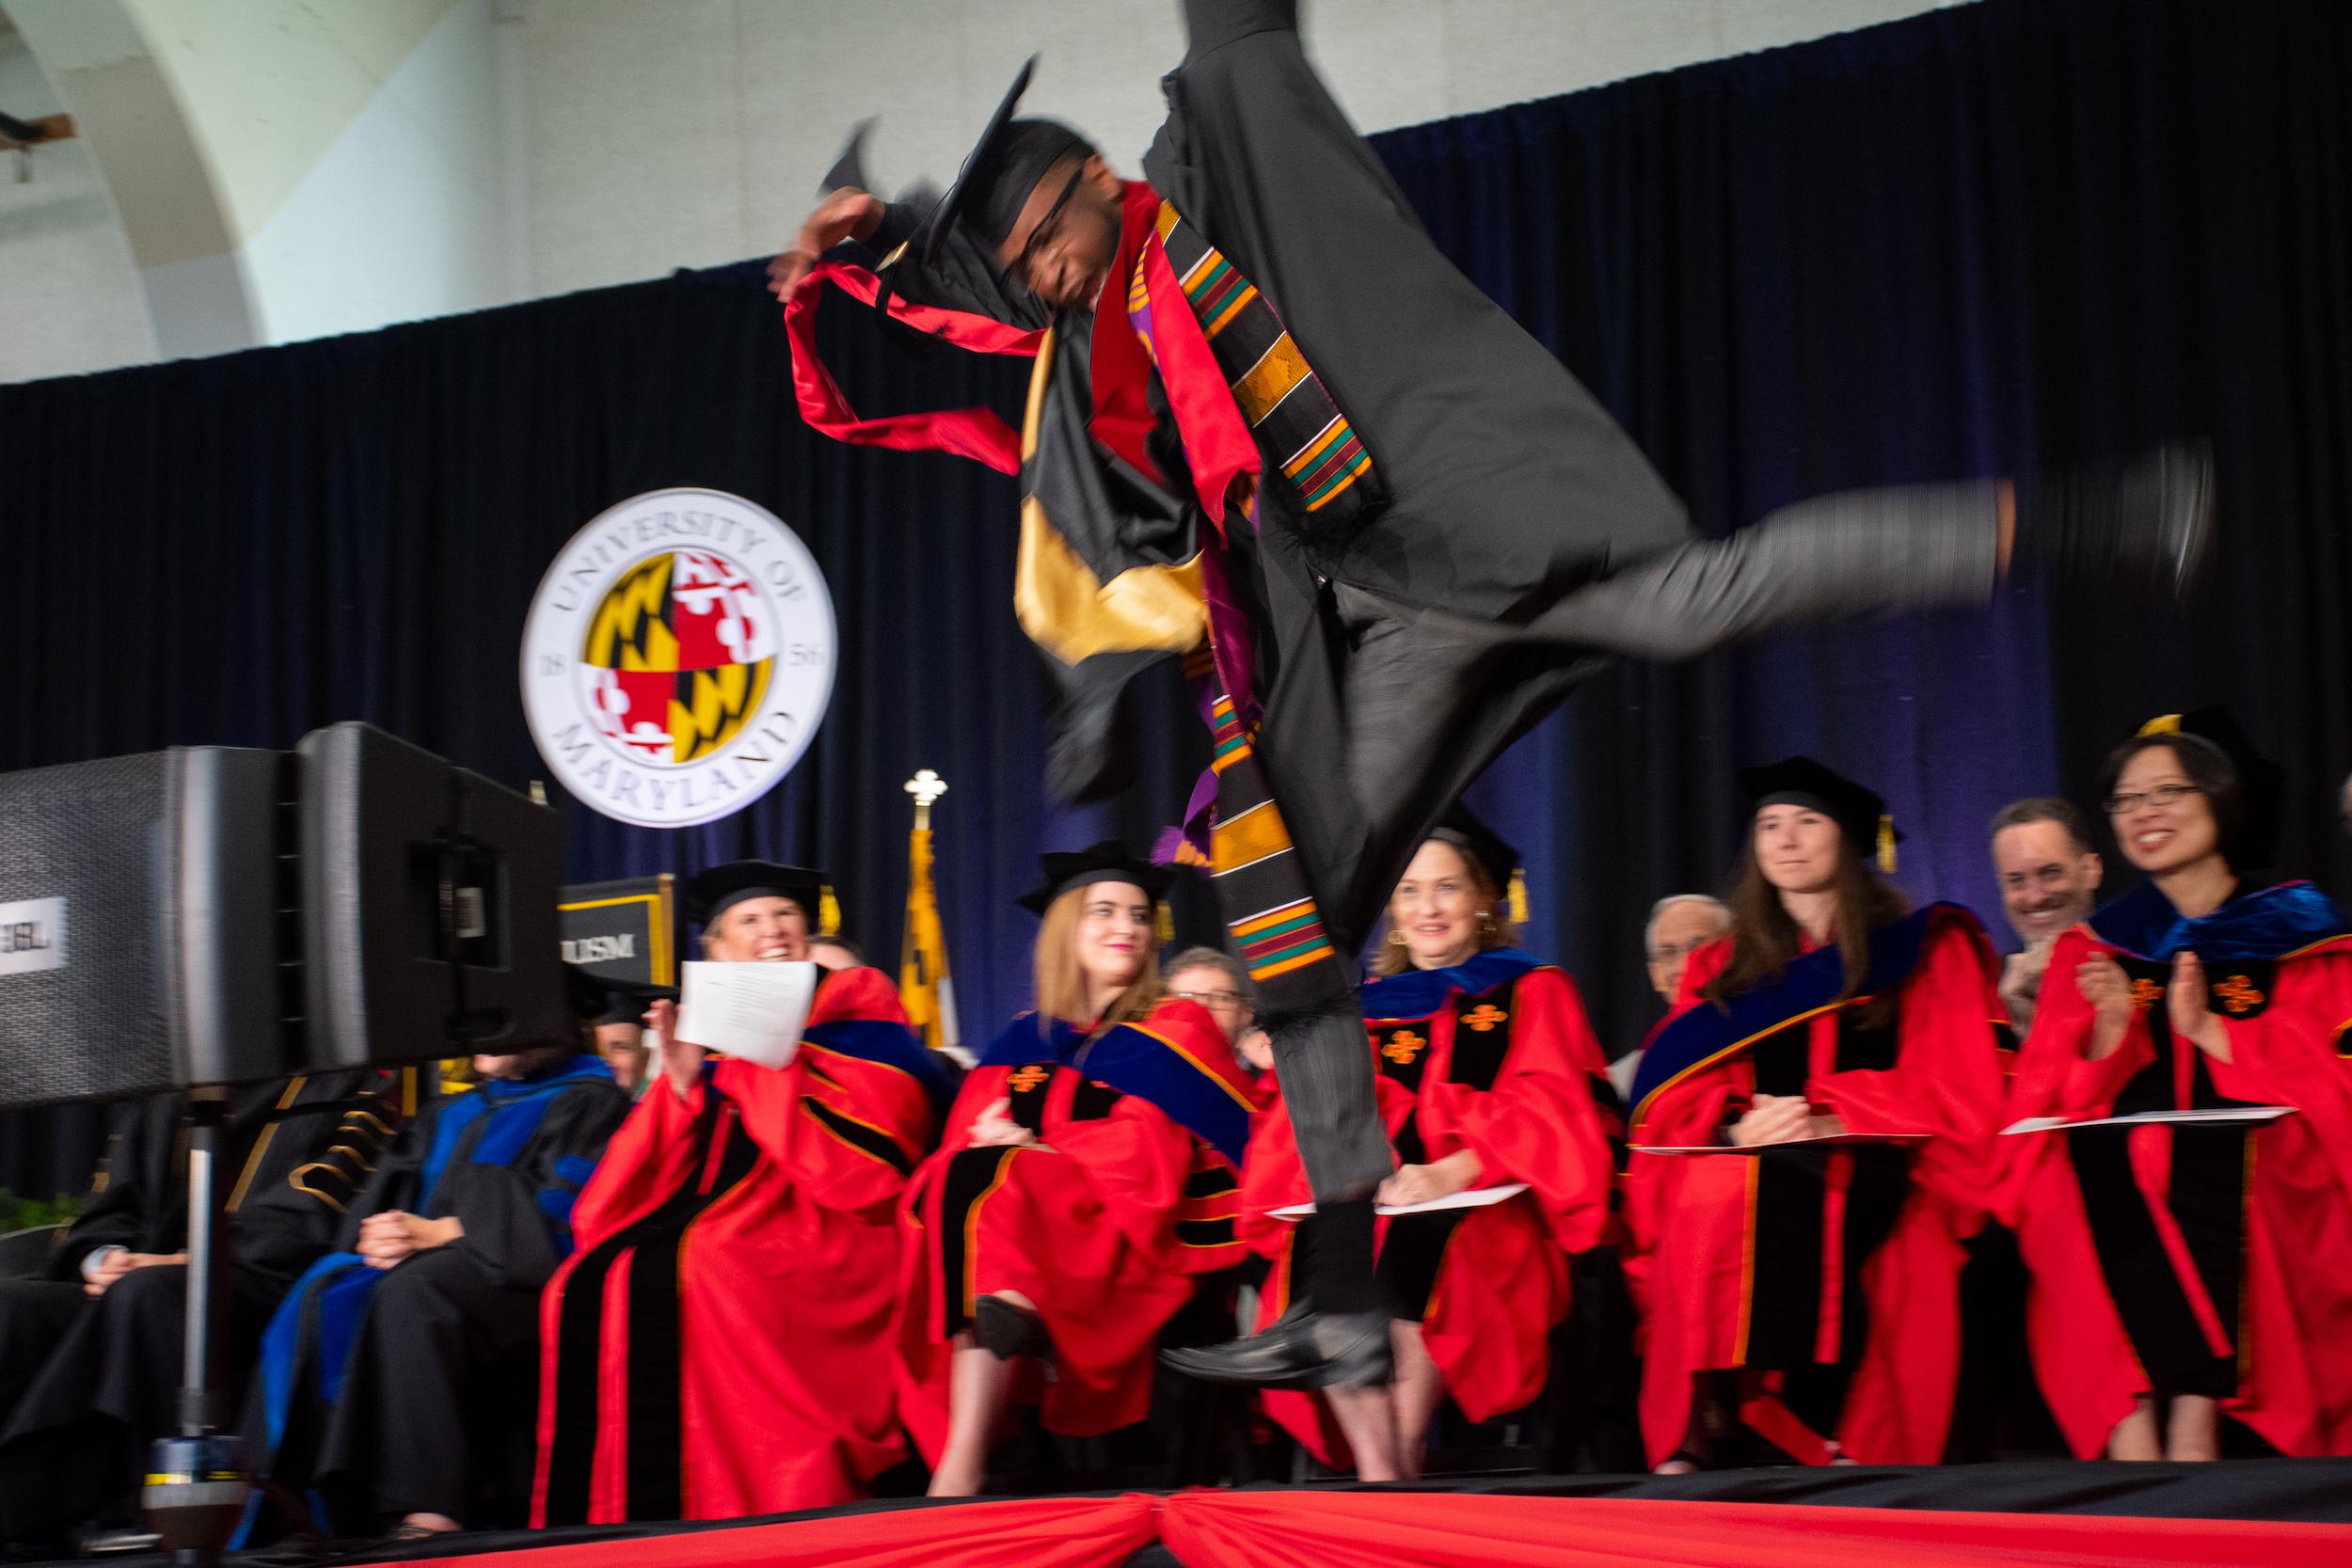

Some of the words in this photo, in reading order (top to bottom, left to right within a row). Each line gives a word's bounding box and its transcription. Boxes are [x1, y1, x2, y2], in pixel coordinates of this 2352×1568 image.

[553, 511, 767, 612] UNIVERSITY
[764, 561, 806, 602] OF
[552, 711, 796, 811] MARYLAND
[560, 933, 635, 964] USM
